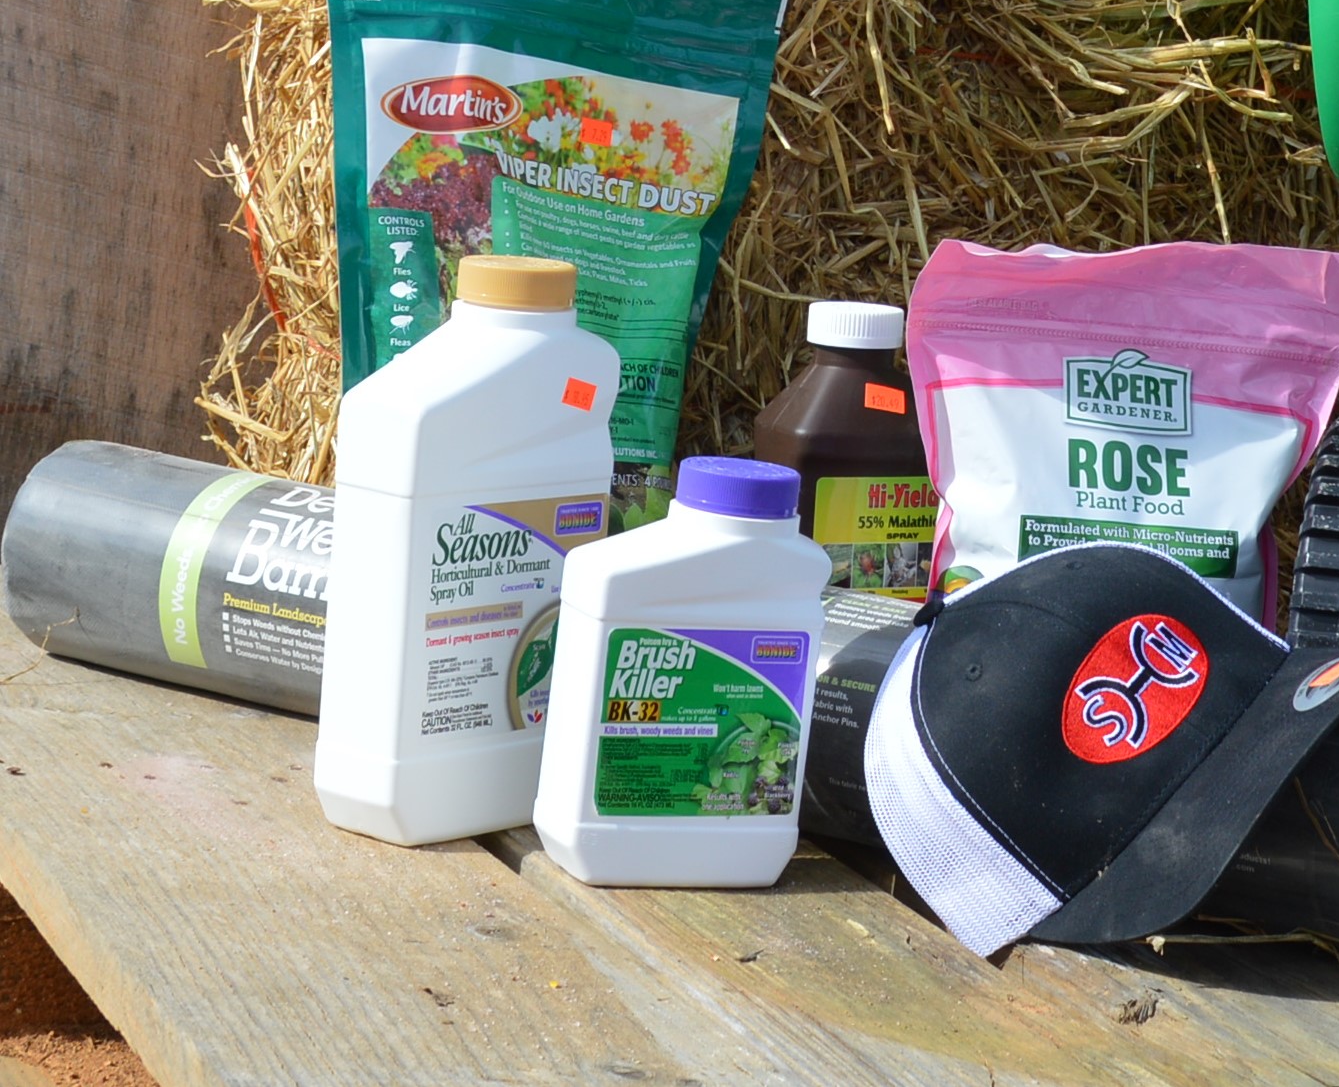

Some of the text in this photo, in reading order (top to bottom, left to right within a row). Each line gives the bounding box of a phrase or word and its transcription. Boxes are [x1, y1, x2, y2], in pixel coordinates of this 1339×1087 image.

[400, 84, 507, 125] Martin's
[495, 148, 716, 216] VIPER INSECT DUST
[502, 182, 645, 228] For Outdoor Use on Home Gardens
[378, 216, 425, 227] CONTROLS
[387, 226, 419, 236] LISTED:
[636, 232, 654, 241] and
[393, 267, 412, 276] Flies
[393, 304, 410, 312] Lice
[390, 338, 412, 347] Fleas
[637, 364, 649, 373] OF
[1077, 368, 1178, 408] EXPERT
[1077, 401, 1173, 422] GARDENER
[1068, 438, 1191, 497] ROSE
[1076, 490, 1185, 516] Plant Food
[453, 513, 476, 536] All
[558, 513, 598, 530] BONIDE
[858, 515, 936, 529] 55% Malathi
[259, 508, 334, 556] We
[886, 532, 919, 540] SPRAY
[1025, 519, 1100, 536] Formulated
[1103, 526, 1130, 538] with
[1132, 528, 1234, 546] Micro-Nutrients
[432, 523, 532, 566] Seasons
[1028, 535, 1040, 546] to
[1206, 547, 1230, 559] and
[431, 558, 551, 584] Horticultural & Dormant
[430, 580, 474, 605] Spray Oil
[501, 582, 536, 593] Concentrate
[223, 592, 270, 614] Premium
[174, 617, 187, 645] No
[232, 614, 301, 637] Stops Weeds without
[506, 627, 520, 638] spray
[232, 626, 294, 647] Lets Water and
[281, 647, 310, 661] No More
[616, 640, 696, 670] Brush
[756, 645, 797, 658] BONIDE
[609, 669, 683, 699] Killer
[831, 676, 839, 686] &
[841, 679, 877, 693] SECURE
[820, 689, 849, 701] results,
[608, 700, 660, 722] BK-32
[677, 705, 717, 715] Concentrate
[835, 704, 853, 714] with
[421, 716, 451, 728] CAUTION
[812, 712, 860, 729] Anchor Pins.
[604, 725, 713, 737] Kills brush, woody weeds and vines
